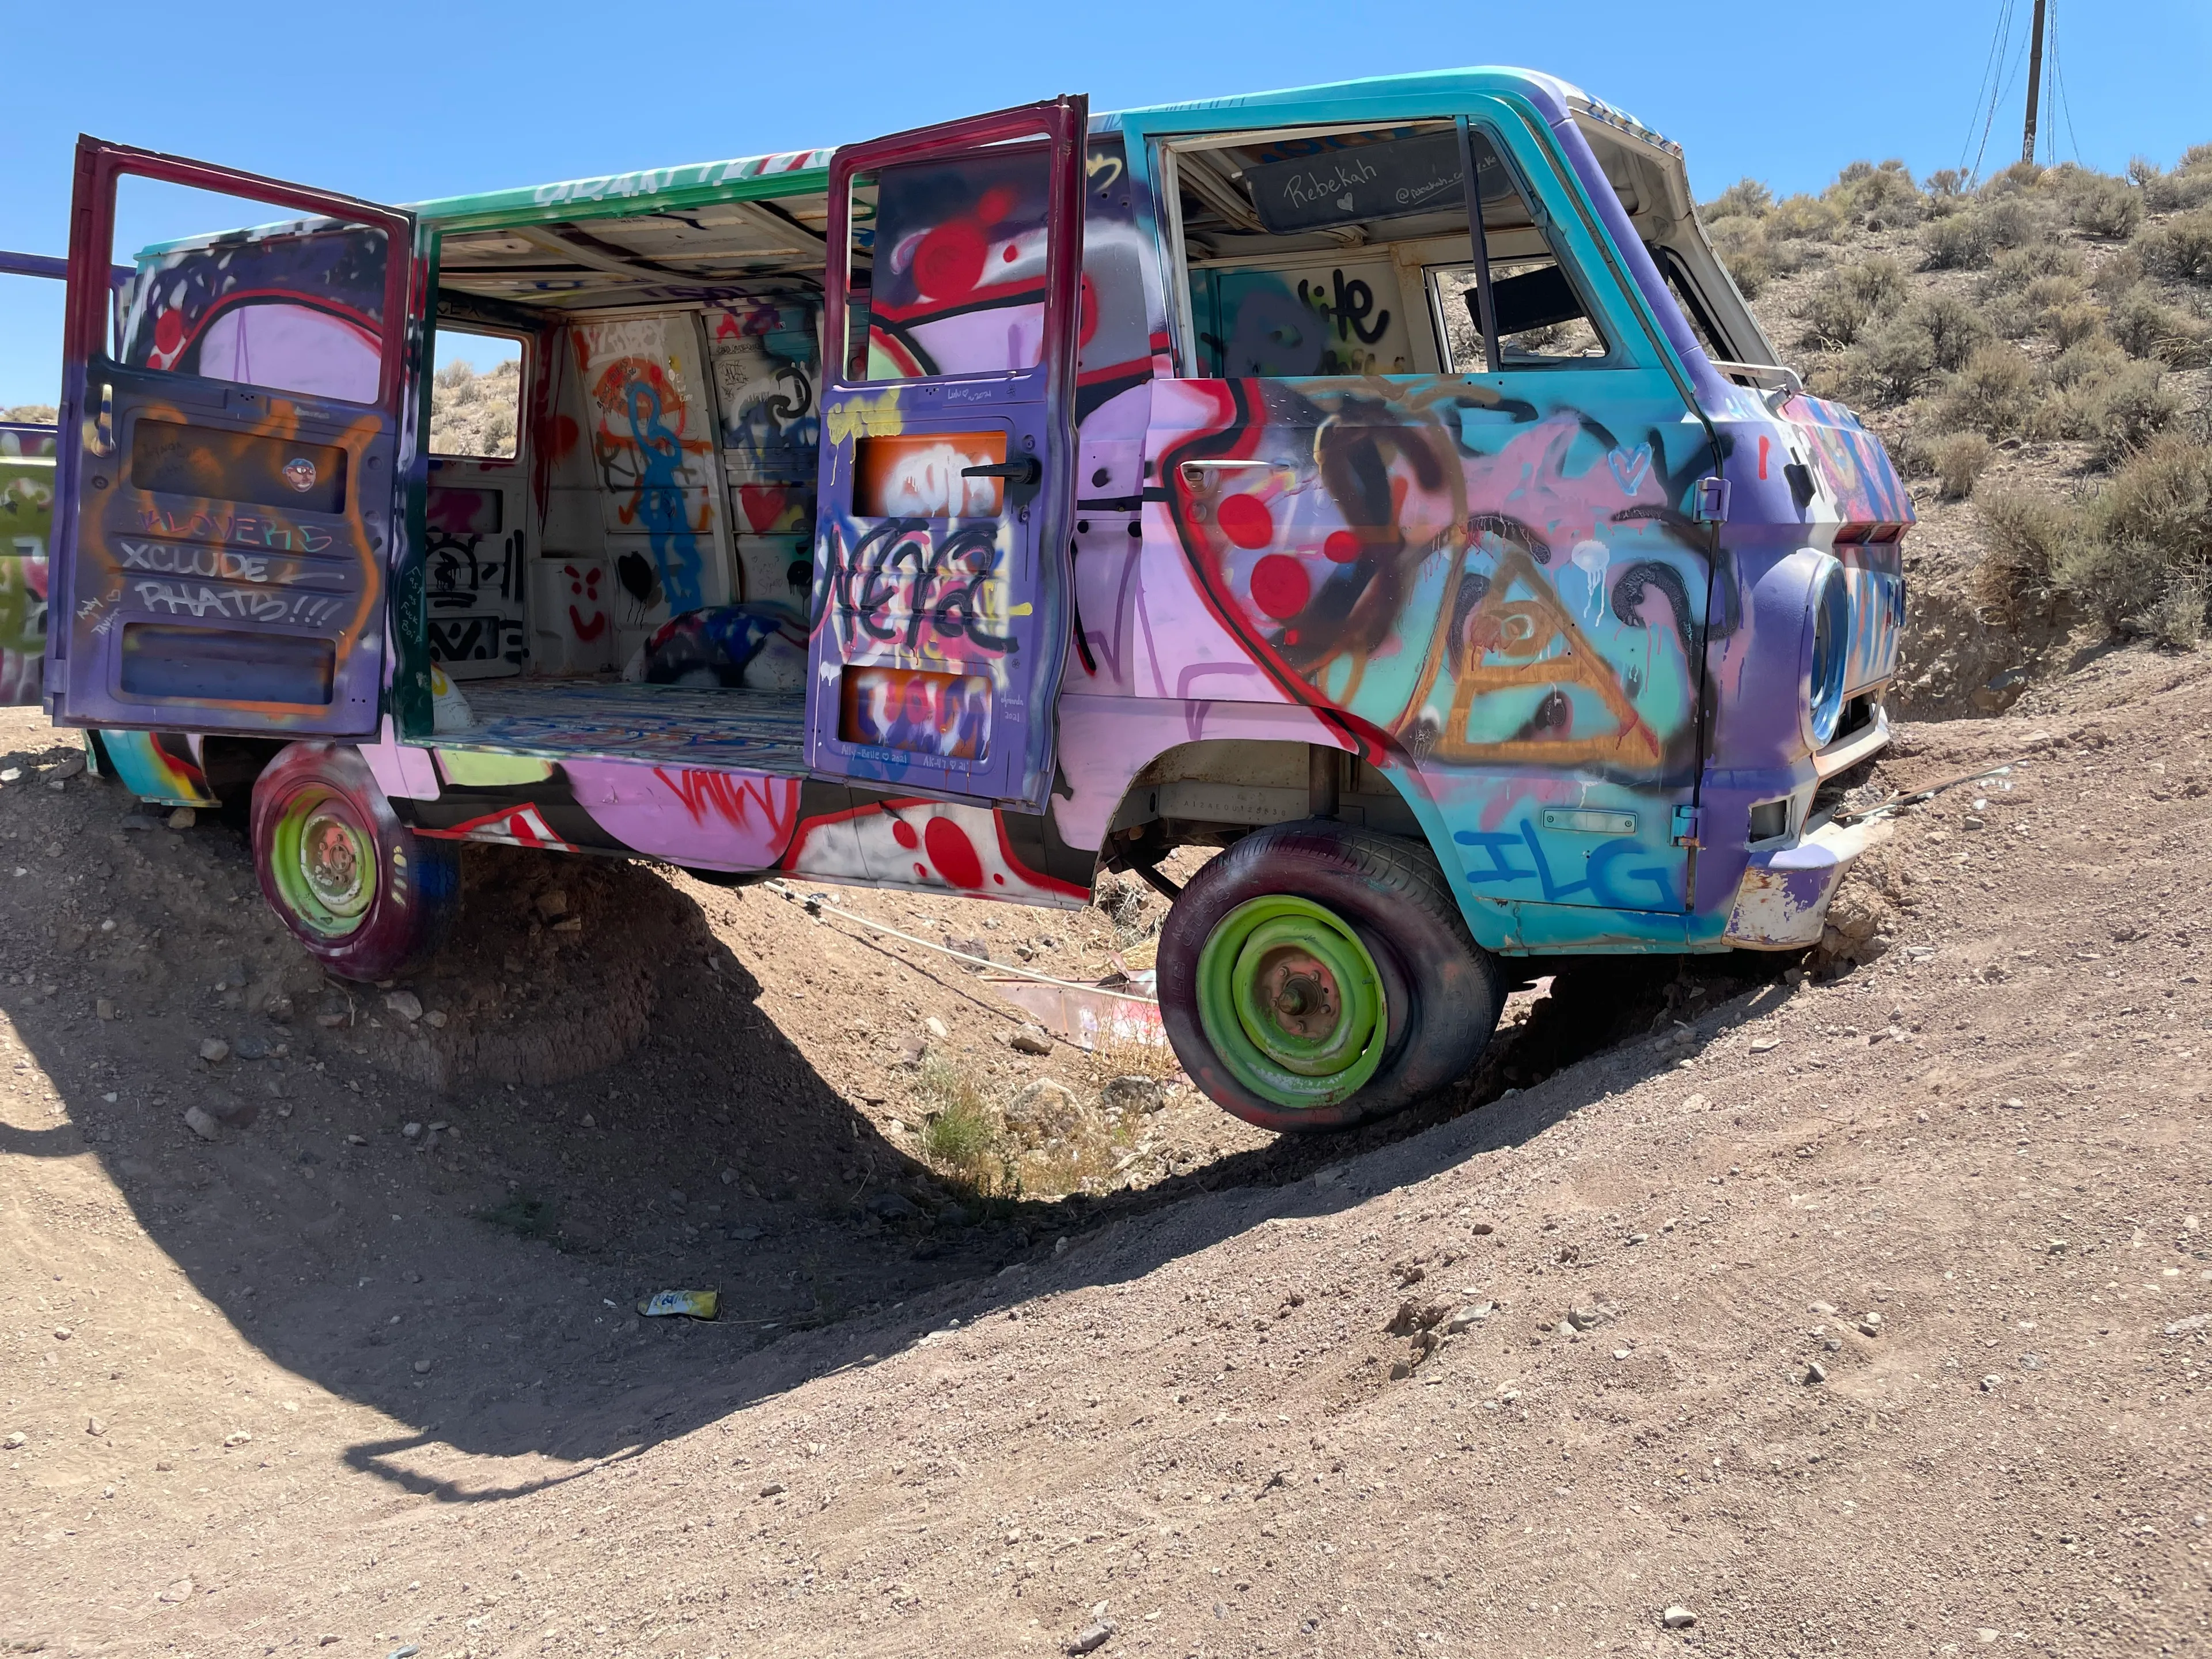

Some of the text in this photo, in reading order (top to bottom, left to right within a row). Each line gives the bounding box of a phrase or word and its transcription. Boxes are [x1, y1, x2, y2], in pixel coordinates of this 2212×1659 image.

[1283, 158, 1377, 209] Rebekah
[120, 541, 269, 582] XCLUDE
[1004, 711, 1020, 723] 2021
